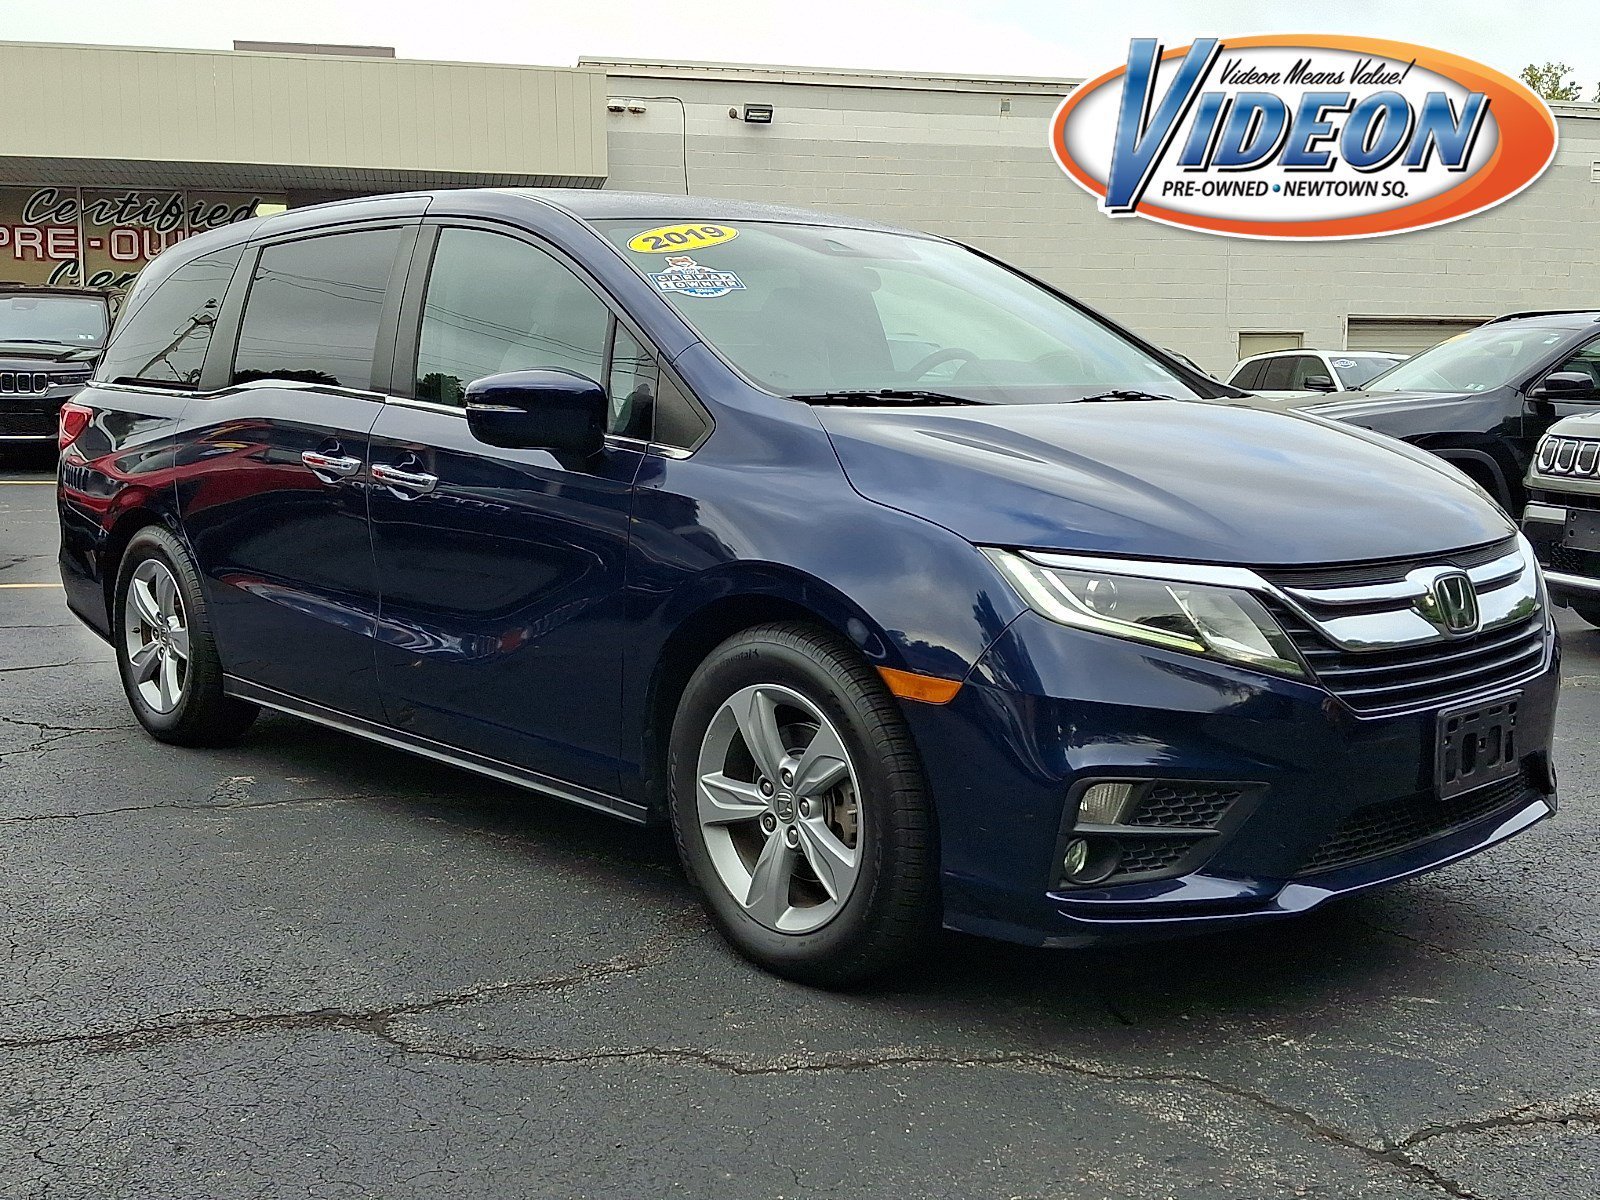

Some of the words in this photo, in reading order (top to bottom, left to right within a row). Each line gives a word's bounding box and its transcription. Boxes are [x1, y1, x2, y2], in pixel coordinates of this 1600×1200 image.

[22, 187, 261, 233] Certified
[641, 225, 725, 250] 2019
[656, 273, 732, 282] CARFAX
[674, 280, 740, 288] OWNER
